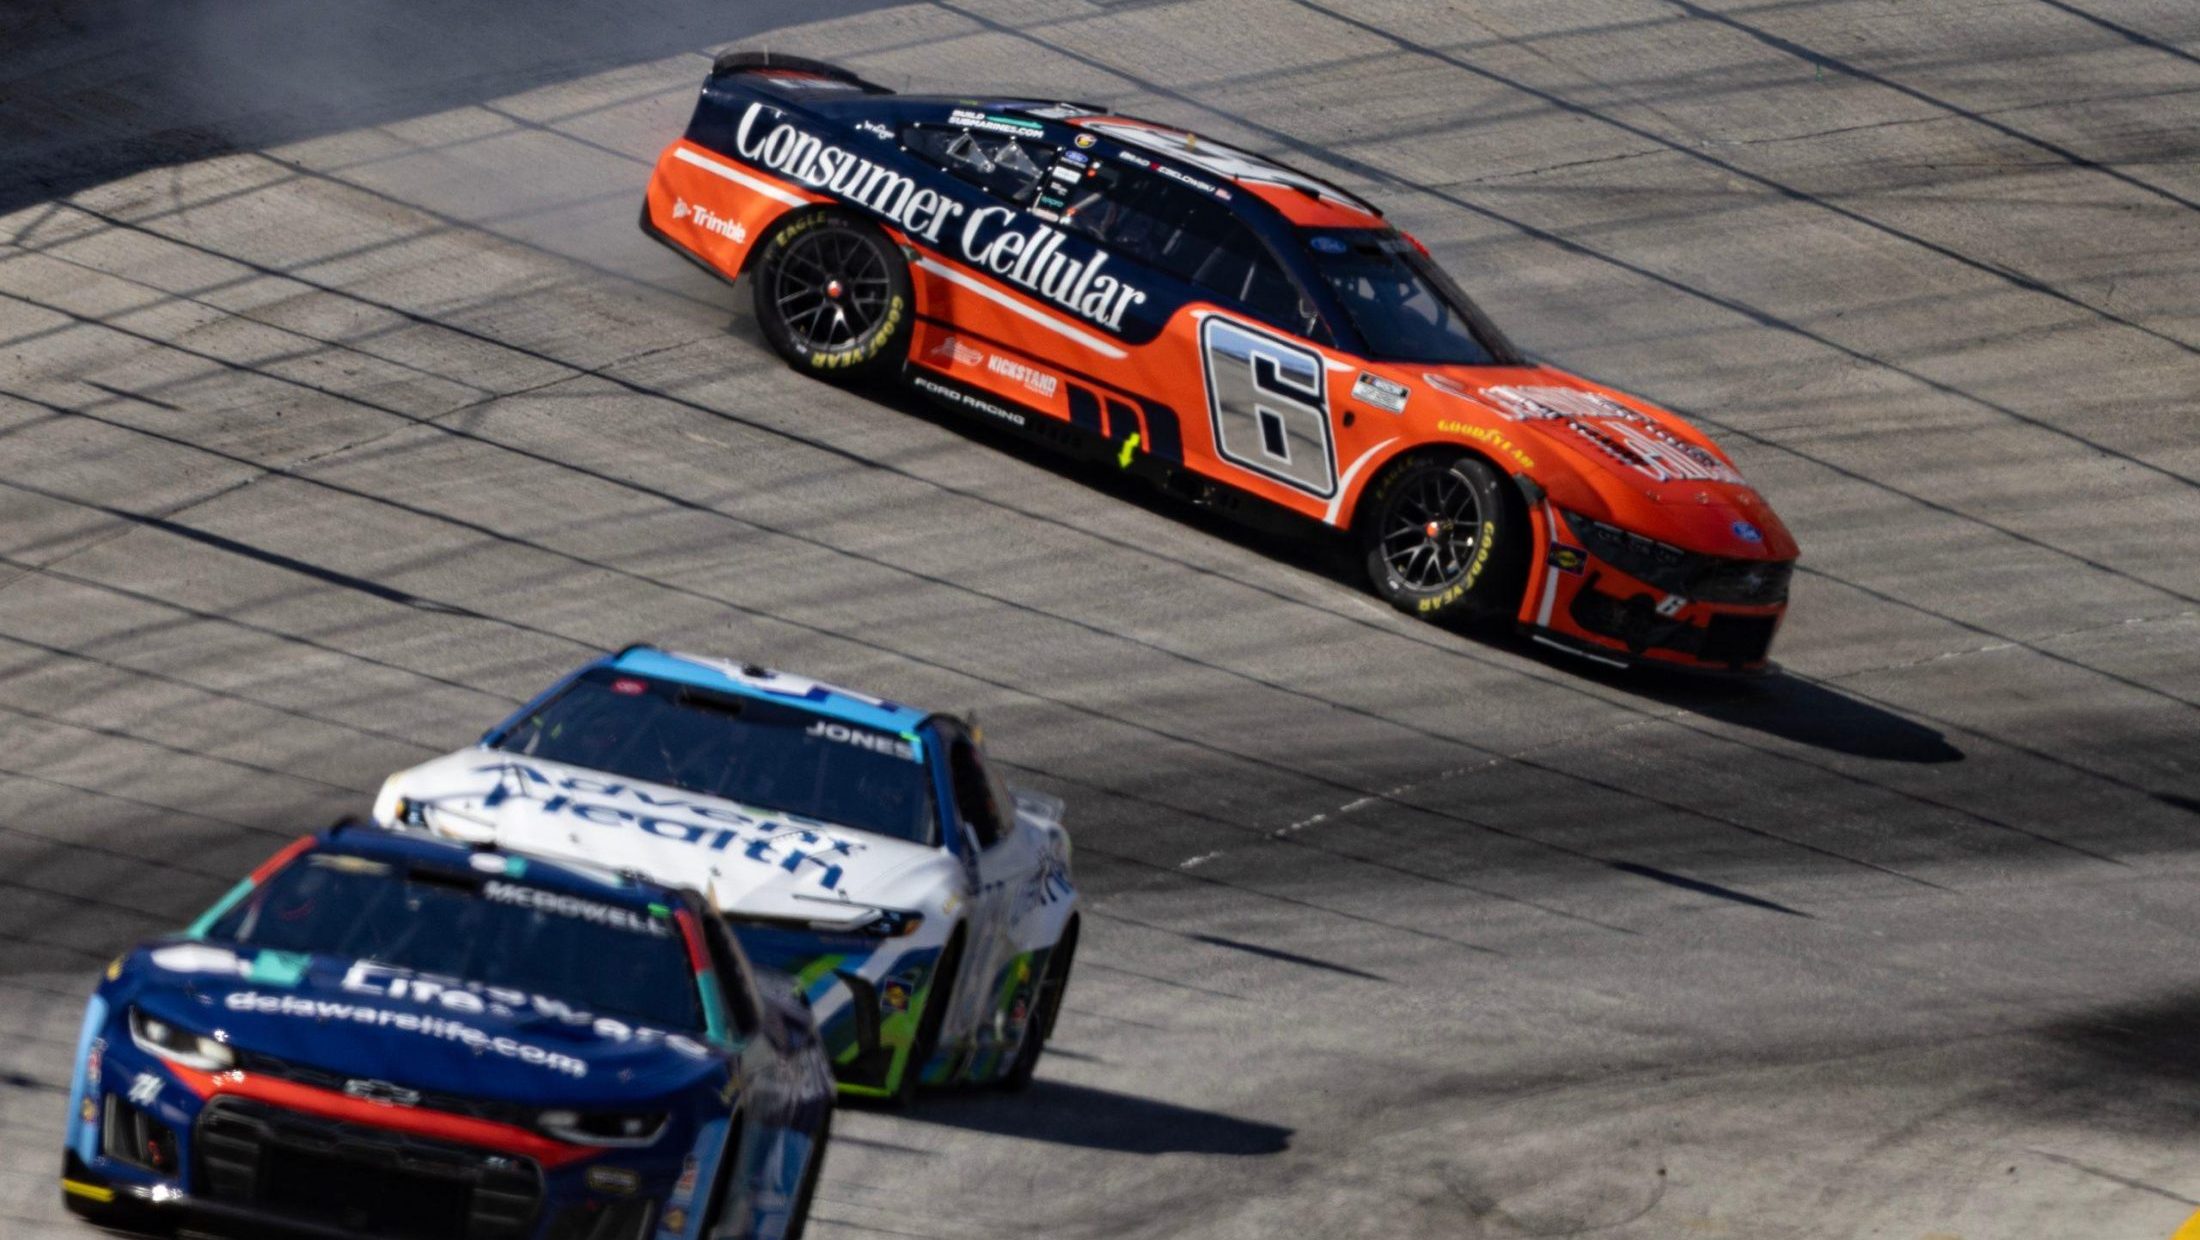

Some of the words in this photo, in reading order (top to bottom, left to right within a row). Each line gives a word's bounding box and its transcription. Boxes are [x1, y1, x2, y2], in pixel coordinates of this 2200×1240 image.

[947, 115, 1044, 139] SUBMARINES.COM
[951, 109, 986, 121] BUILD
[692, 204, 746, 245] Trimble
[736, 102, 963, 244] Consumer
[960, 205, 1147, 332] Cellular
[775, 211, 828, 247] EAGLE
[987, 354, 1058, 393] KICKSTAND
[914, 377, 962, 401] FORD
[962, 395, 1026, 426] RACING
[1198, 313, 1339, 500] 6
[805, 719, 916, 761] JONES
[483, 880, 669, 937] MCDOWELL
[225, 990, 589, 1078] delawarelife.com
